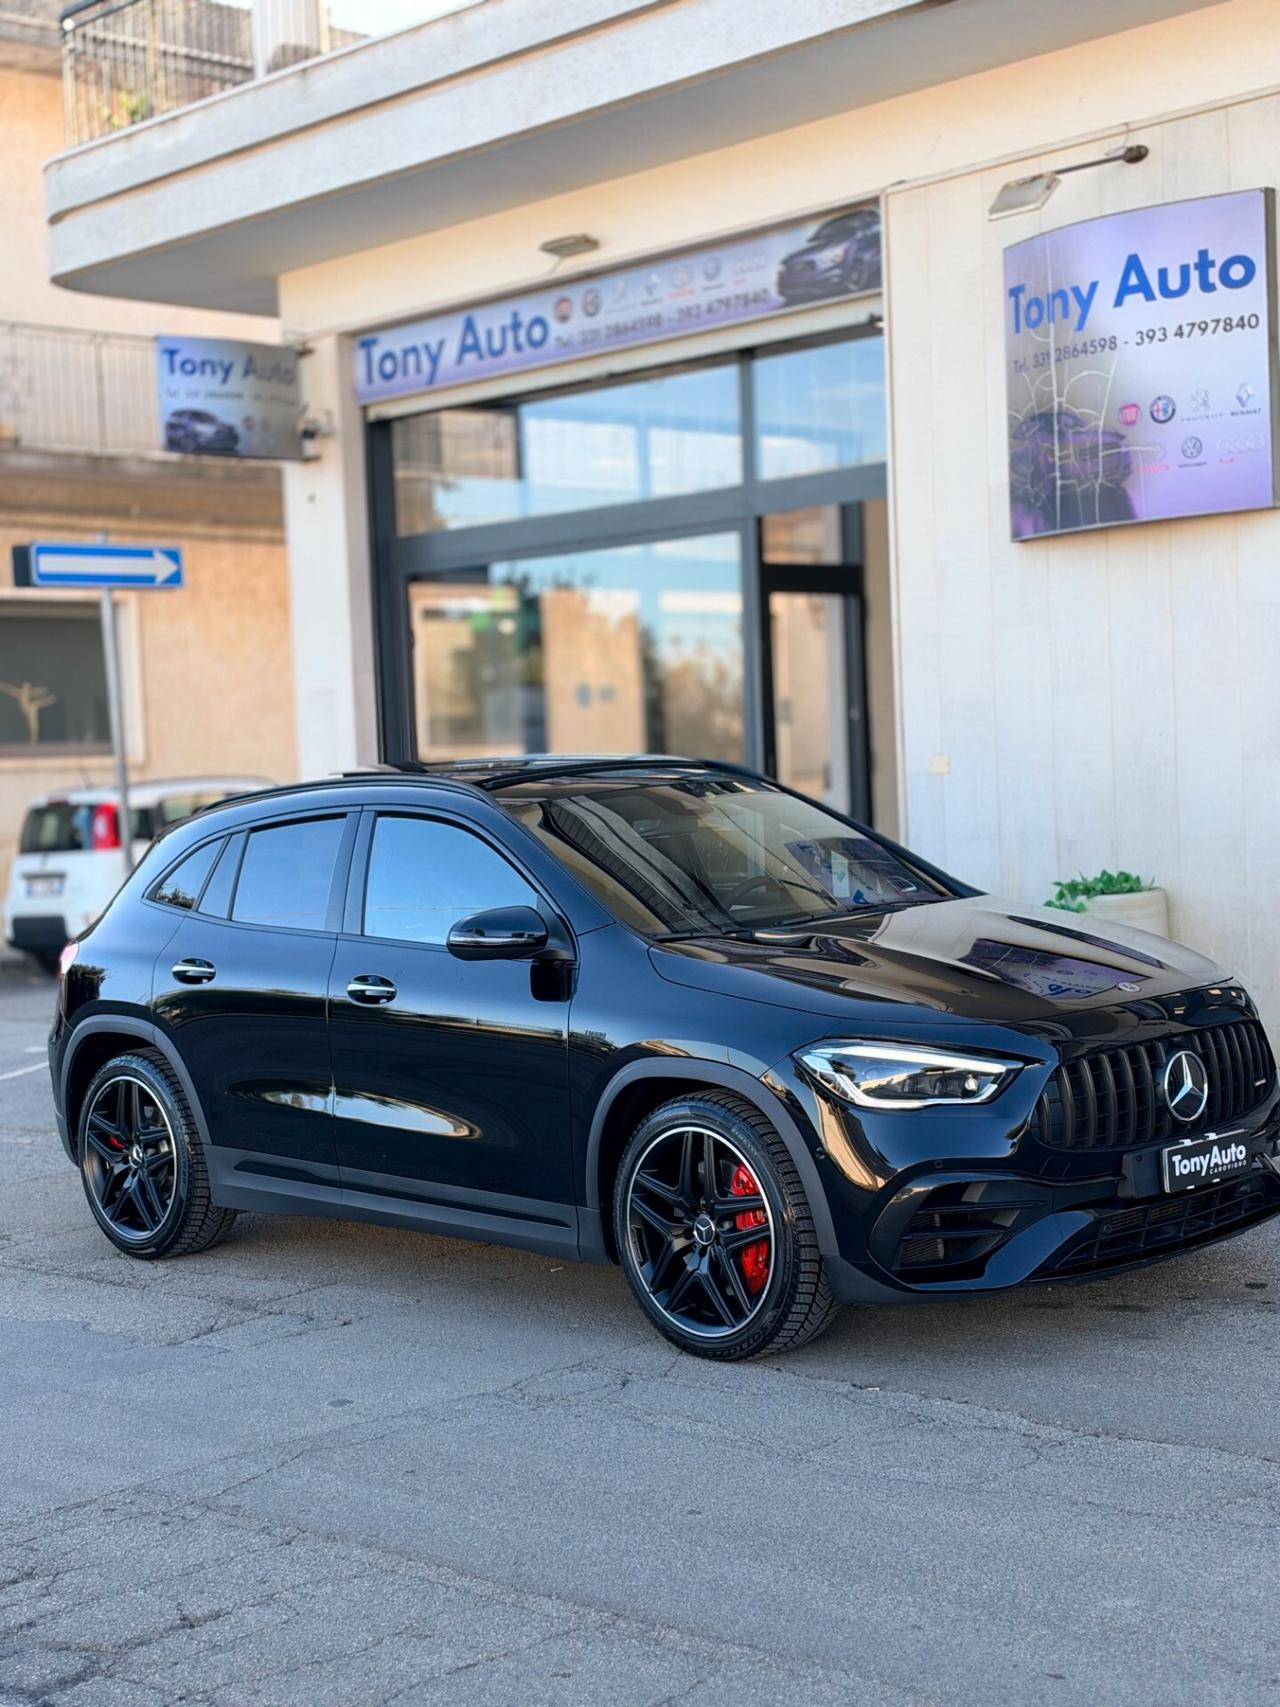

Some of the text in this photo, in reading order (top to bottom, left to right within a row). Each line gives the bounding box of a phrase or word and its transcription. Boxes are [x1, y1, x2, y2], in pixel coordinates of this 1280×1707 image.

[1009, 249, 1256, 334] Tony Auto
[162, 348, 234, 385] Tony
[358, 311, 549, 385] Tony Auto
[1055, 335, 1118, 363] 2864598
[1135, 326, 1168, 346] 393
[1174, 313, 1260, 340] 4797840
